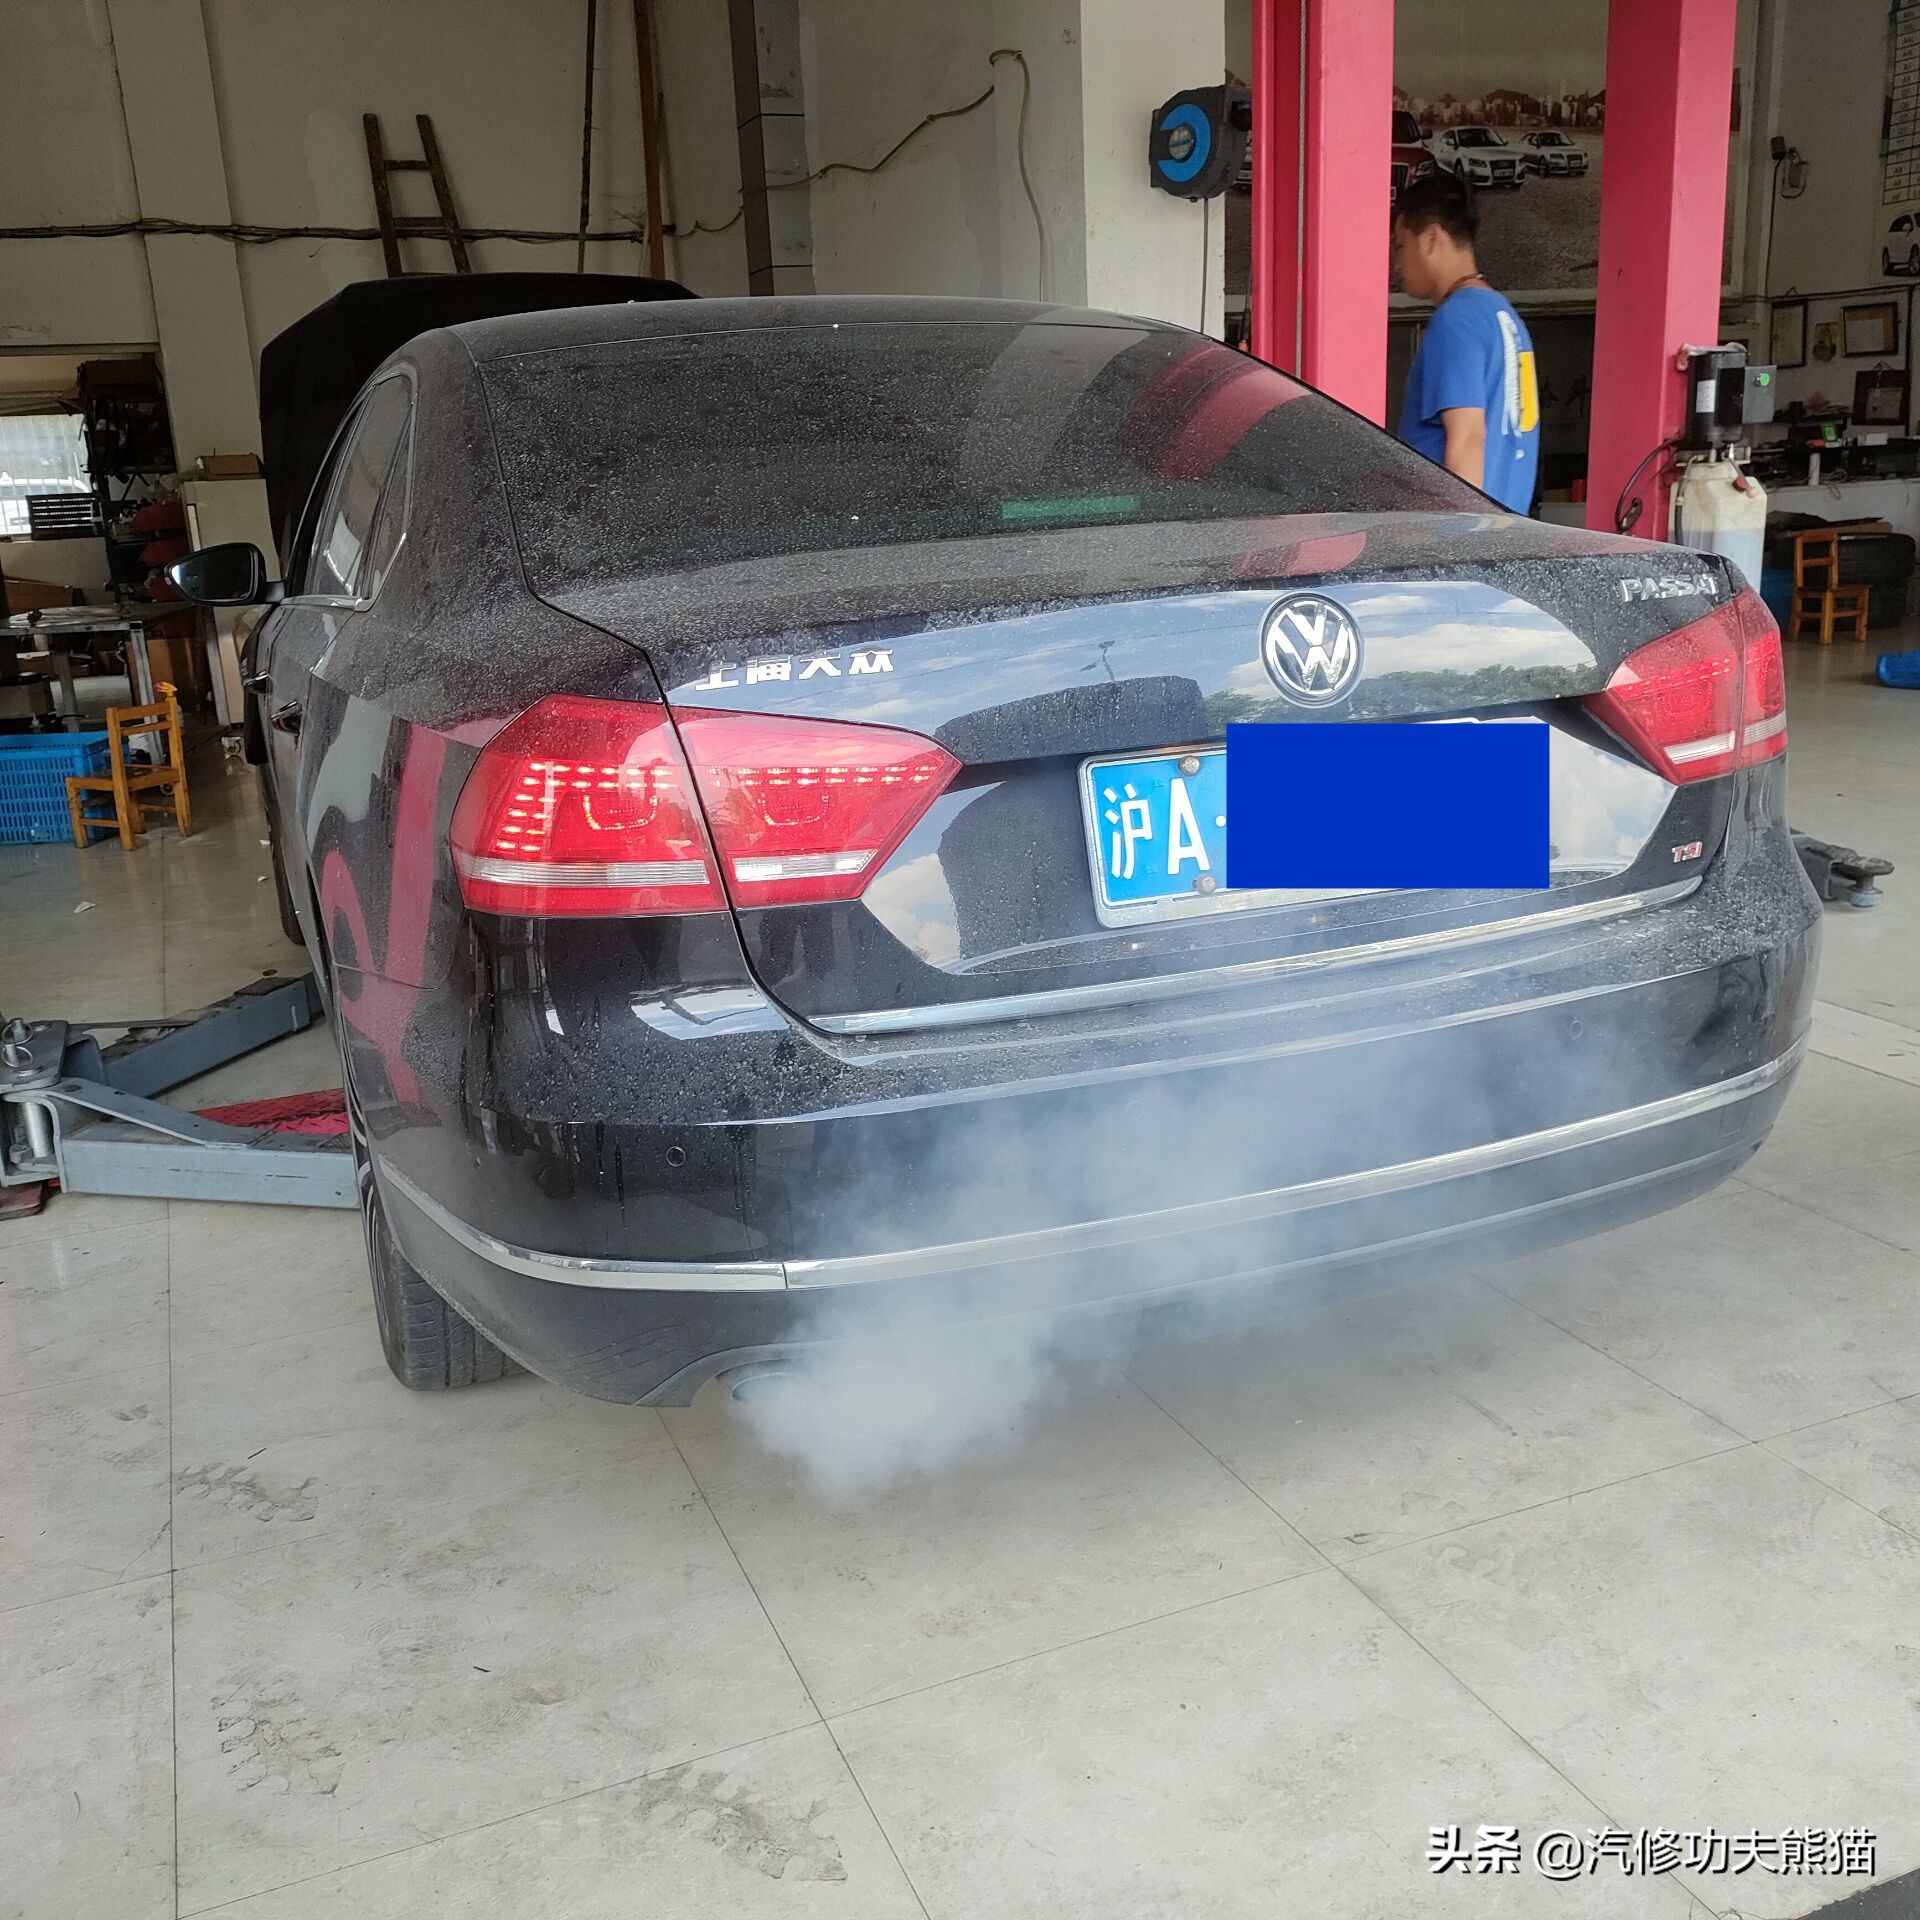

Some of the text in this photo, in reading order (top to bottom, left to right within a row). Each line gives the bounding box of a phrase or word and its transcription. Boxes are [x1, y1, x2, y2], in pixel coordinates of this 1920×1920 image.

[1620, 574, 1718, 602] PASSAT
[695, 649, 894, 691] 上海大众
[1671, 841, 1703, 863] TSI
